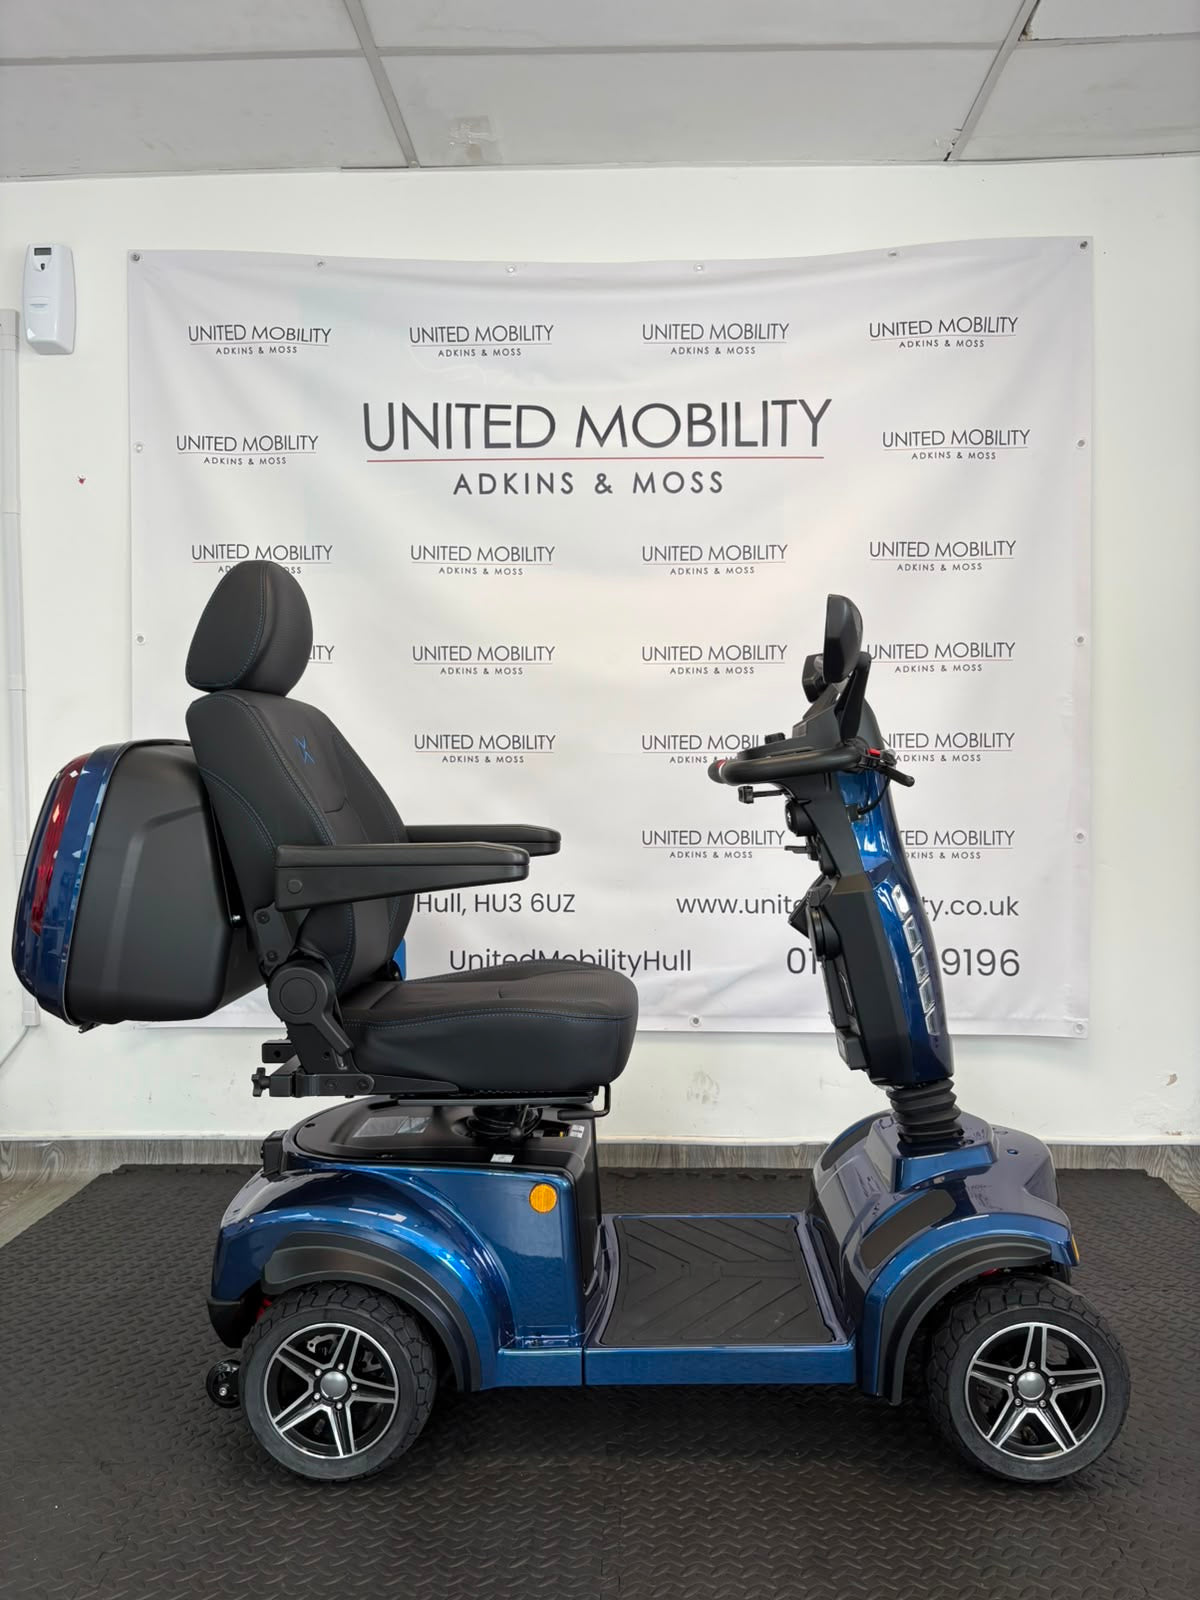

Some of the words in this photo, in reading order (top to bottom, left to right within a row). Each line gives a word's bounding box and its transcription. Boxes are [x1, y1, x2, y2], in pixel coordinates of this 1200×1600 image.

[188, 324, 247, 342] UNITED
[251, 325, 332, 343] MOBILITY
[409, 326, 470, 344] UNITED
[475, 324, 554, 342] MOBILITY
[642, 323, 704, 341] UNITED
[709, 323, 789, 340] MOBILITY
[870, 320, 932, 338] UNITED
[938, 316, 1018, 334] MOBILITY
[216, 346, 253, 355] ADKINS
[258, 346, 264, 354] &
[269, 345, 297, 354] MOSS
[670, 346, 709, 355] ADKINS
[714, 347, 721, 355] &
[726, 346, 755, 355] MOSS
[899, 339, 939, 348] ADKINS
[944, 339, 951, 347] &
[956, 339, 984, 348] MOSS
[438, 348, 476, 357] ADKINS
[481, 349, 488, 357] &
[493, 348, 521, 356] MOSS
[363, 402, 556, 452] UNITED
[575, 398, 832, 449] MOBILITY
[176, 435, 237, 452] UNITED
[242, 434, 319, 452] MOBILITY
[882, 430, 946, 448] UNITED
[950, 429, 1030, 446] MOBILITY
[203, 456, 243, 466] ADKINS
[259, 456, 286, 465] MOSS
[911, 451, 951, 460] ADKINS
[956, 451, 963, 459] &
[968, 451, 996, 460] MOSS
[453, 472, 574, 495] ADKINS
[594, 472, 613, 495] &
[632, 470, 723, 494] MOSS
[192, 543, 250, 560] UNITED
[255, 545, 333, 561] MOBILITY
[411, 545, 472, 561] UNITED
[477, 546, 555, 562] MOBILITY
[642, 545, 703, 562] UNITED
[708, 544, 788, 561] MOBILITY
[870, 541, 930, 558] UNITED
[934, 540, 1016, 558] MOBILITY
[439, 566, 477, 575] ADKINS
[494, 567, 523, 576] MOSS
[670, 567, 709, 575] ADKINS
[714, 567, 720, 575] &
[725, 566, 754, 574] MOSS
[897, 563, 935, 572] ADKINS
[940, 564, 947, 572] &
[952, 562, 982, 571] MOSS
[412, 645, 472, 661] UNITED
[477, 645, 556, 662] MOBILITY
[642, 645, 703, 662] UNITED
[708, 644, 788, 661] MOBILITY
[934, 642, 1016, 659] MOBILITY
[440, 667, 478, 675] ADKINS
[483, 667, 489, 675] &
[495, 667, 523, 675] MOSS
[670, 666, 709, 675] ADKINS
[713, 667, 720, 675] &
[725, 666, 754, 674] MOSS
[895, 664, 935, 673] ADKINS
[940, 664, 947, 672] &
[953, 663, 982, 672] MOSS
[414, 734, 474, 750] UNITED
[478, 734, 556, 750] MOBILITY
[642, 734, 703, 751] UNITED
[881, 732, 929, 748] NITED
[934, 732, 1015, 749] MOBILITY
[442, 755, 479, 763] ADKINS
[484, 755, 491, 763] &
[496, 755, 524, 763] MOSS
[669, 755, 708, 764] ADKINS
[896, 754, 935, 762] ADKINS
[940, 754, 947, 762] &
[952, 753, 981, 762] MOSS
[642, 830, 702, 846] UNITED
[707, 829, 786, 846] MOBILITY
[933, 829, 1015, 846] MOBILITY
[669, 851, 707, 859] ADKINS
[712, 851, 719, 859] &
[724, 851, 752, 859] MOSS
[905, 851, 934, 859] DKINS
[951, 851, 981, 859] MOSS
[416, 892, 467, 916] Hull,
[474, 892, 522, 913] HU3
[530, 892, 575, 913] 6UZ
[941, 948, 1020, 977] 9196
